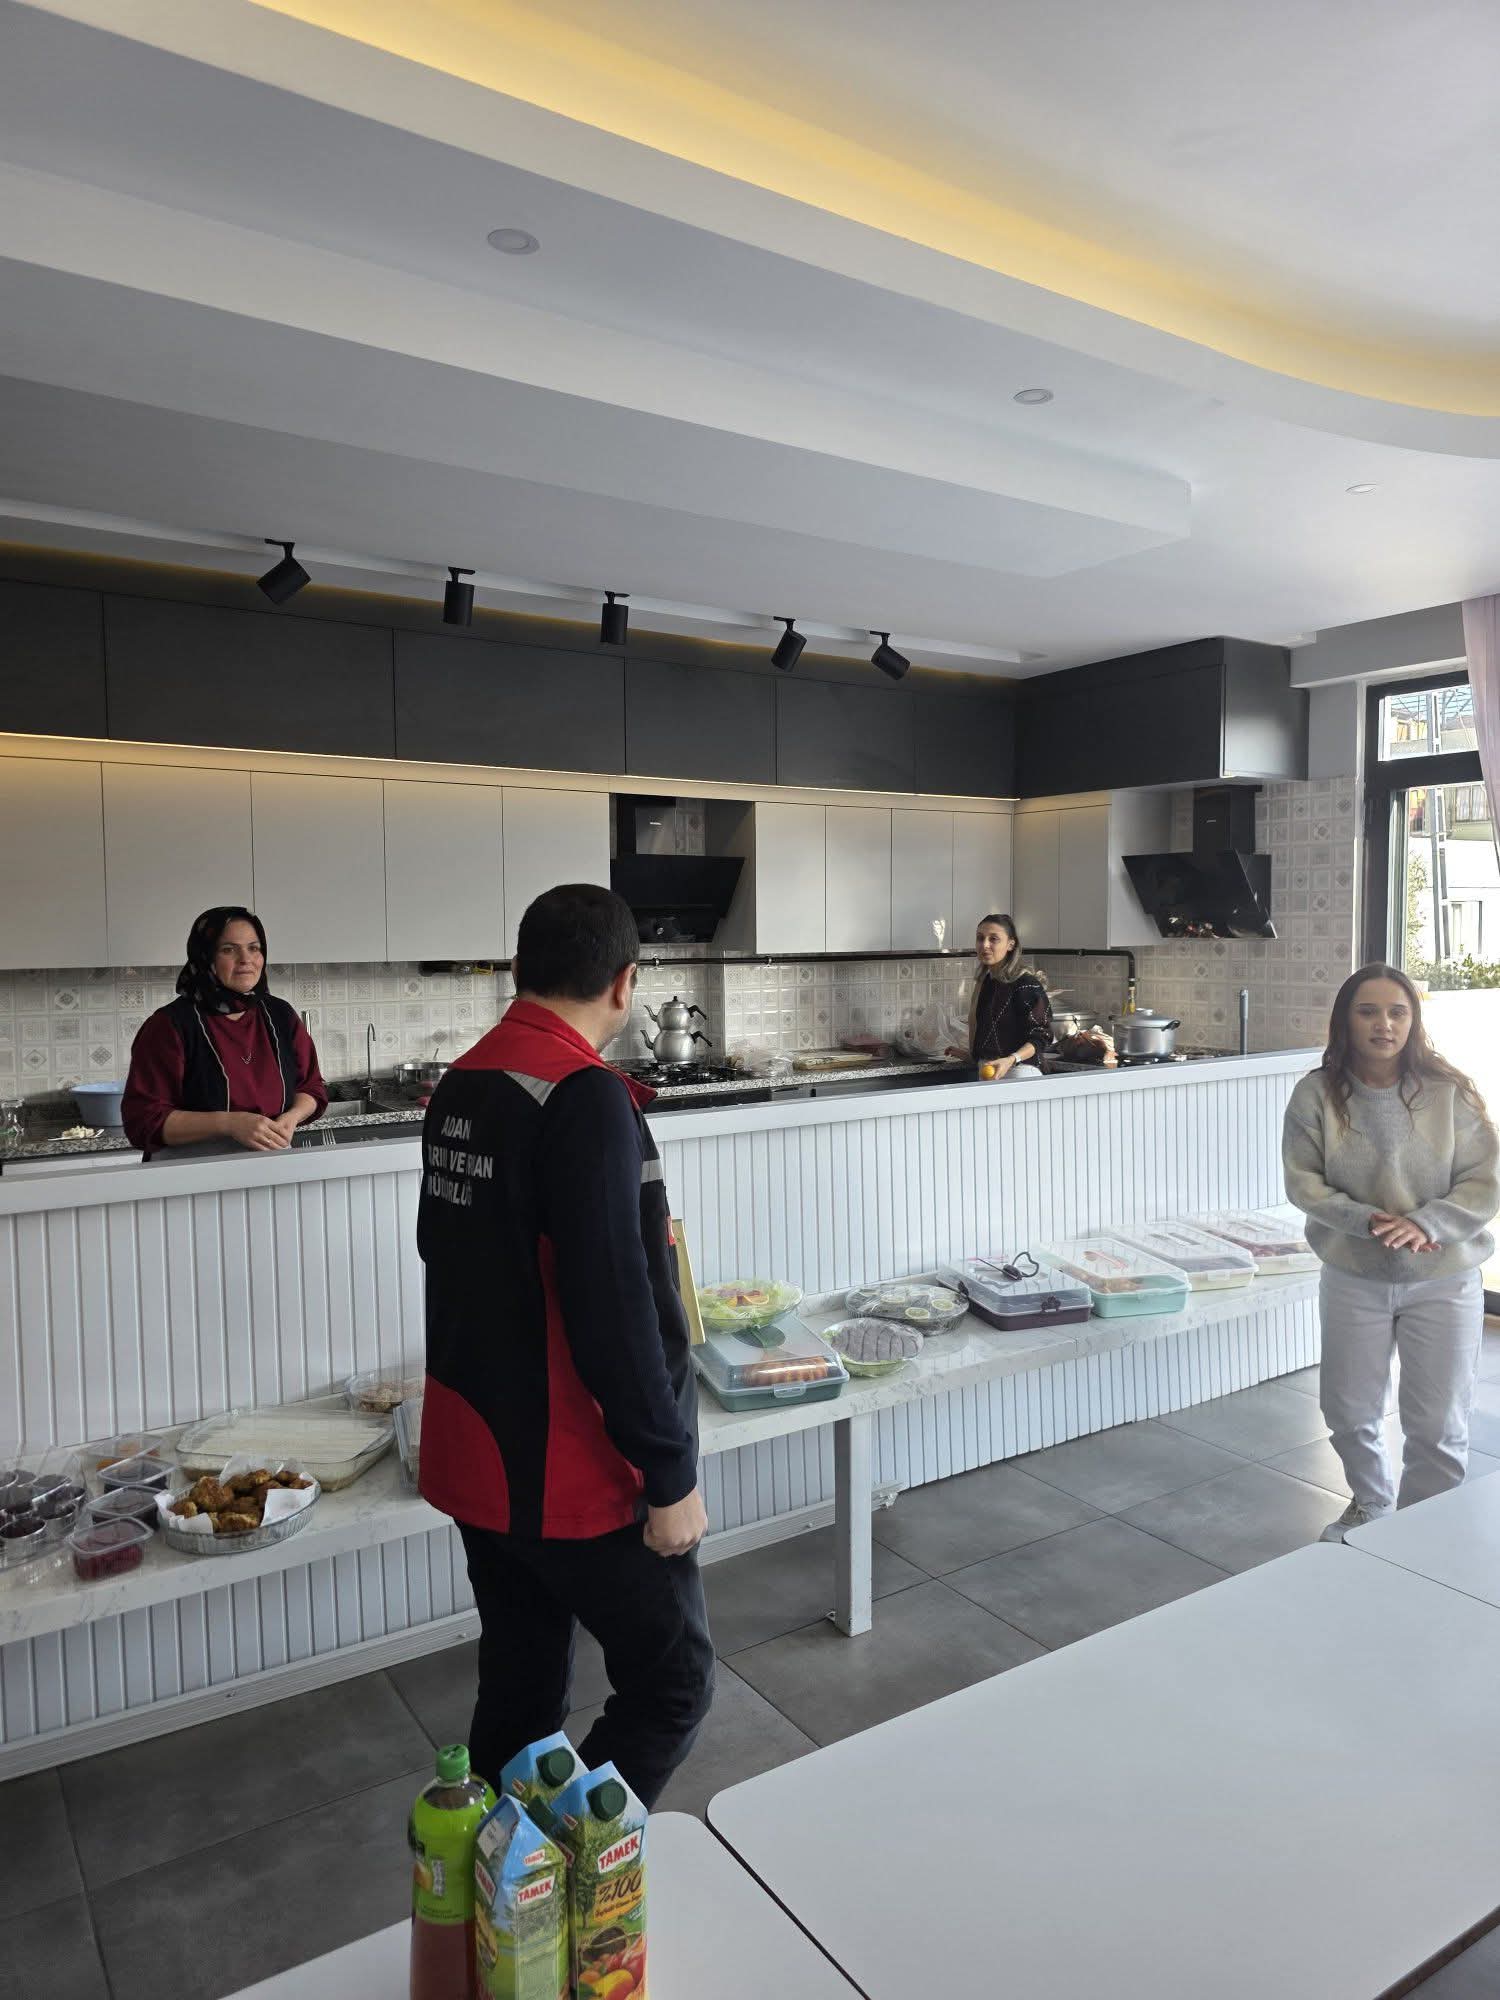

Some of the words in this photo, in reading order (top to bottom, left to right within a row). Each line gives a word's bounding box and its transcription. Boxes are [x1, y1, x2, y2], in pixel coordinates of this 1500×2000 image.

[450, 1150, 466, 1172] VE
[599, 1835, 639, 1870] TAMEK
[518, 1880, 552, 1902] TAMEK
[599, 1869, 642, 1904] %100
